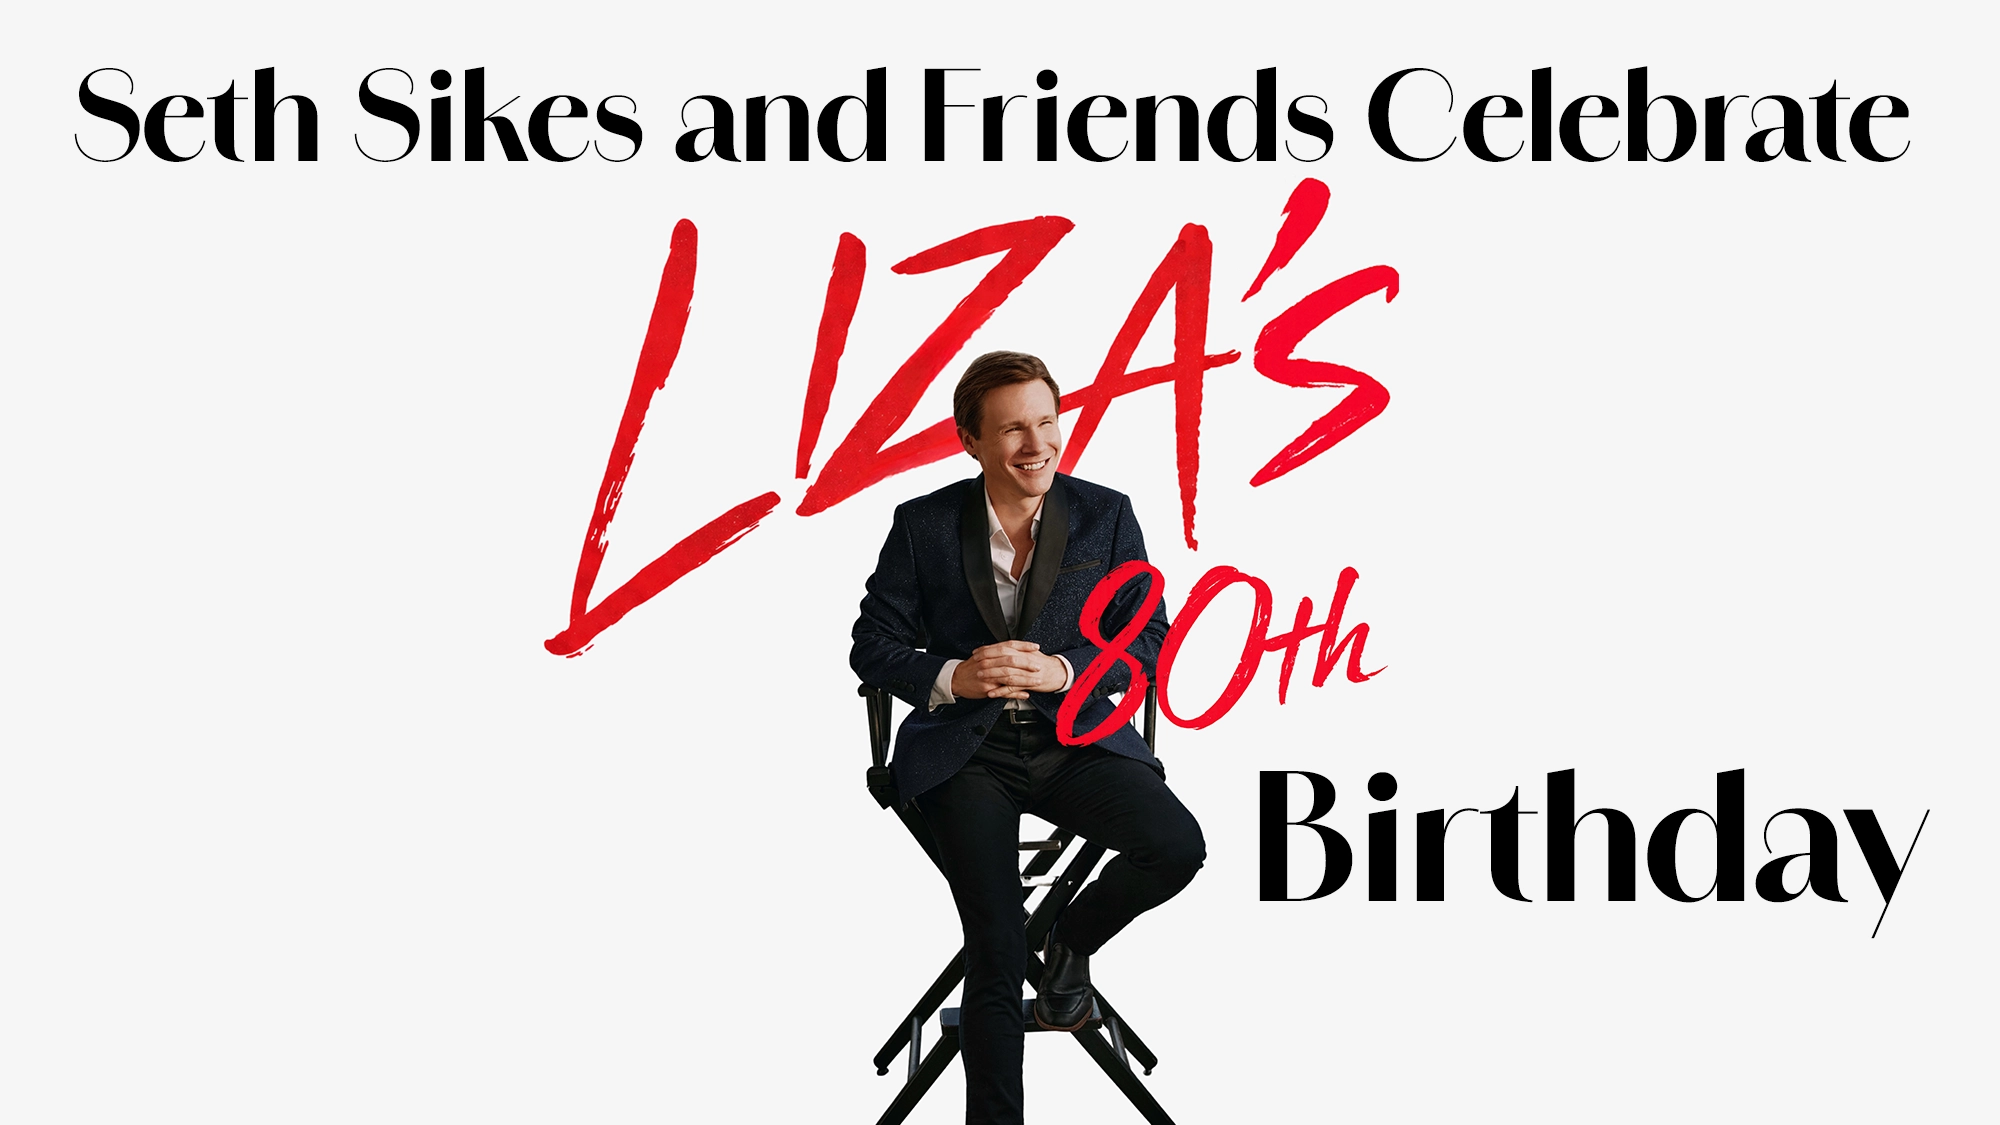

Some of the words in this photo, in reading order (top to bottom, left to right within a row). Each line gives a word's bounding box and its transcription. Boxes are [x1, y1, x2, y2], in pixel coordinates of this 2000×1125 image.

[75, 67, 318, 162] Seth
[355, 67, 642, 162] Sikes
[675, 67, 886, 162] and
[925, 67, 1333, 162] Friends
[1368, 66, 1910, 162] Celebrate
[544, 177, 1400, 659] LIZA's
[1056, 559, 1388, 747] 80th
[1260, 768, 1930, 938] Birthday
